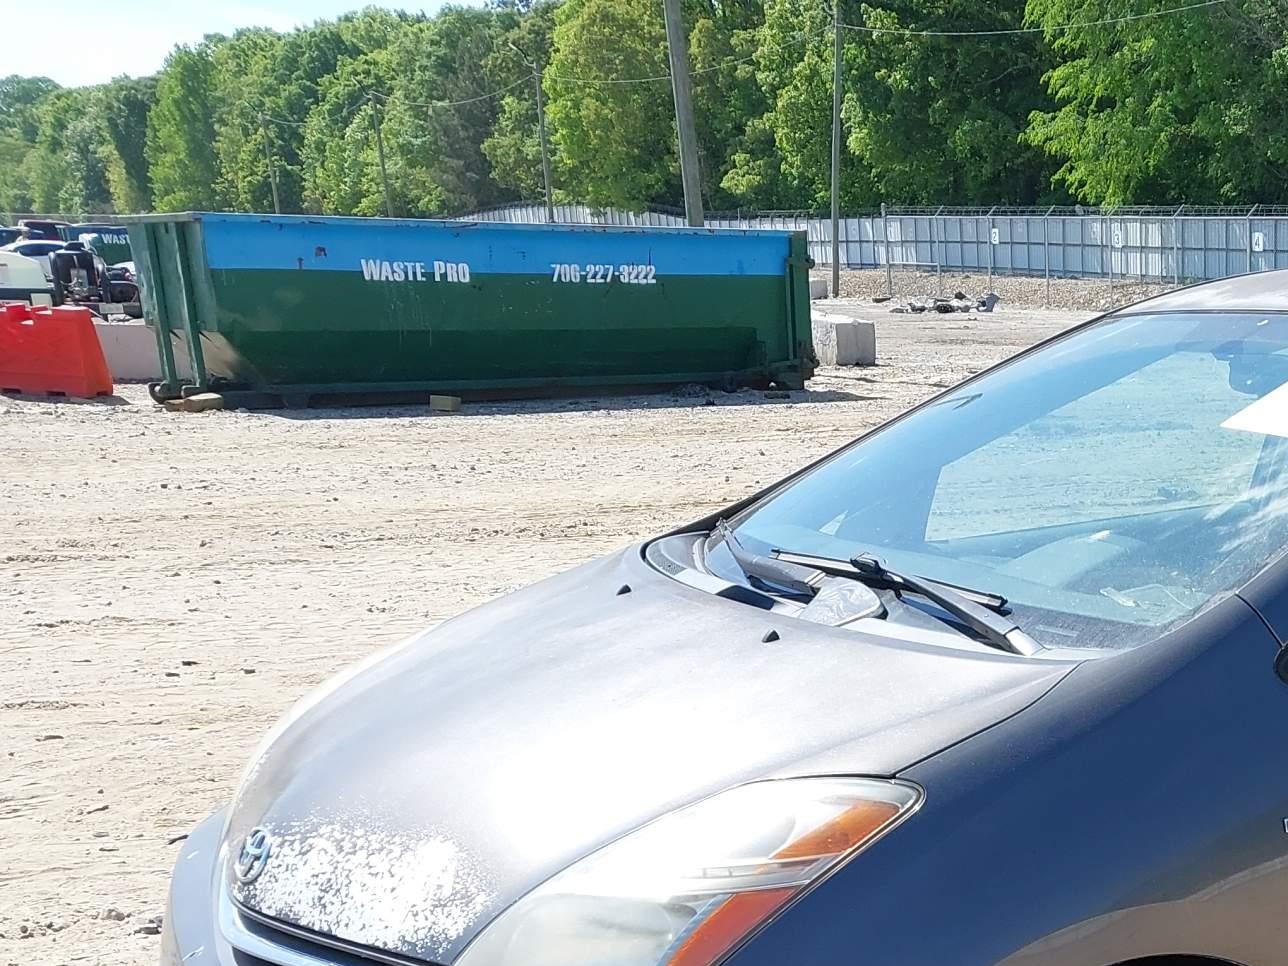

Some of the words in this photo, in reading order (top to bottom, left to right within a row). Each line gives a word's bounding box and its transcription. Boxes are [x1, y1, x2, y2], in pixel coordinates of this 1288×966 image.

[360, 258, 427, 282] WASTE
[433, 260, 471, 283] PRO
[550, 263, 657, 284] 706-227-3222
